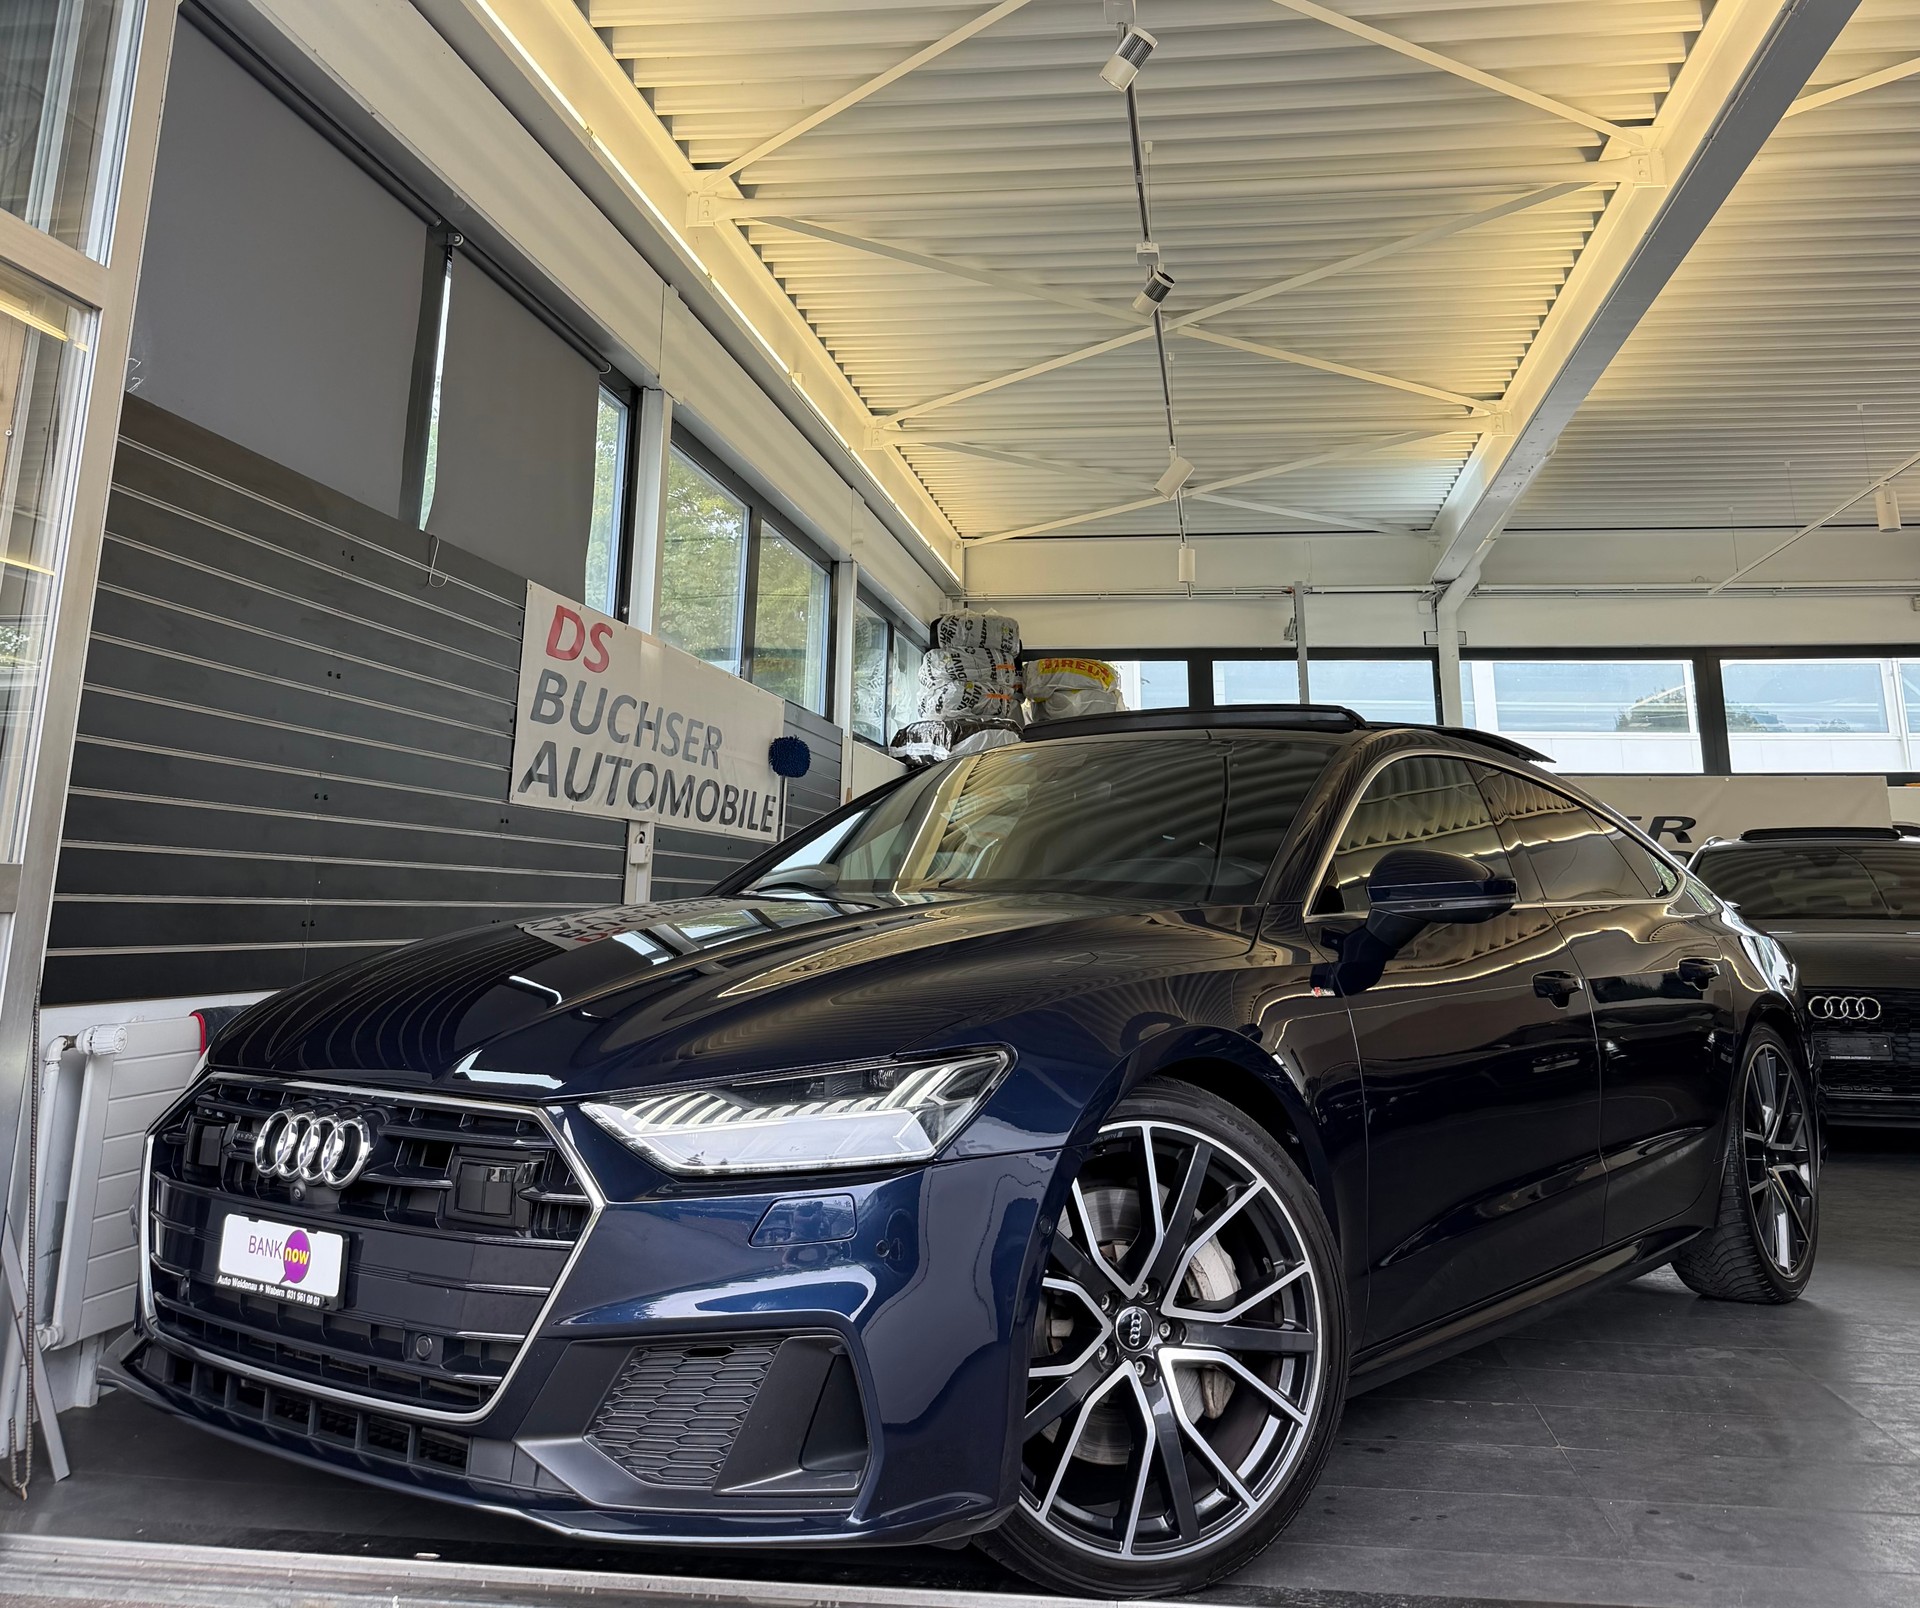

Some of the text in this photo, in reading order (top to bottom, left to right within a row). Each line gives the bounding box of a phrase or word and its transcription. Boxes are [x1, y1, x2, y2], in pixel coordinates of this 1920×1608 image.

[546, 605, 613, 673] DS
[530, 669, 722, 769] BUCHSER
[517, 741, 776, 833] AUTOMOBILE
[217, 1275, 231, 1286] Auto
[248, 1235, 310, 1265] BANK now
